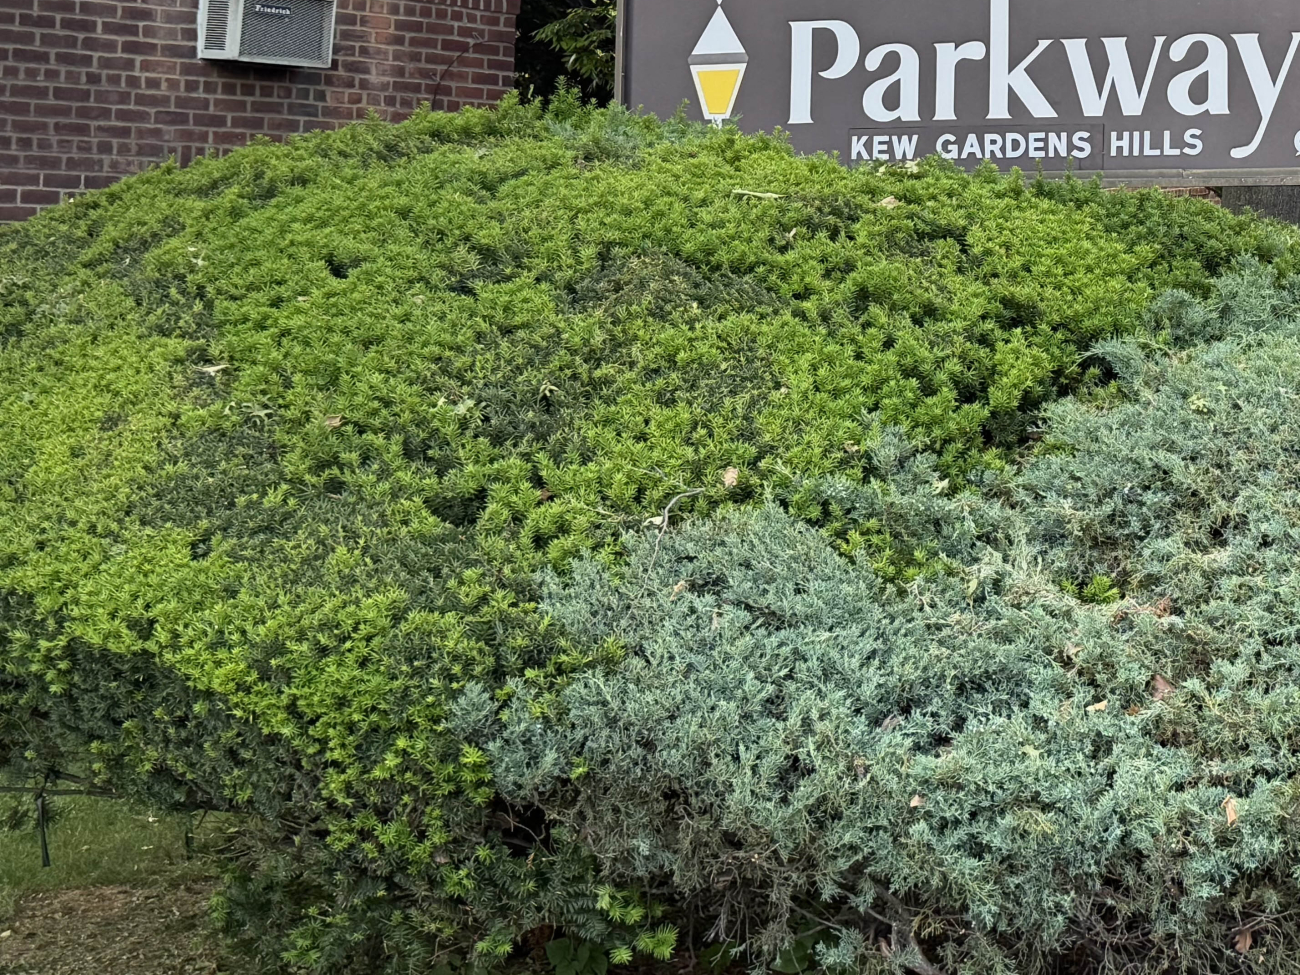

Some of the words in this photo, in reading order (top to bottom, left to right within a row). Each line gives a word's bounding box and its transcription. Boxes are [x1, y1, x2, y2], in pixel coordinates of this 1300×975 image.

[850, 134, 919, 161] KEW
[935, 131, 1092, 160] GARDENS
[1110, 129, 1204, 157] HILLS
